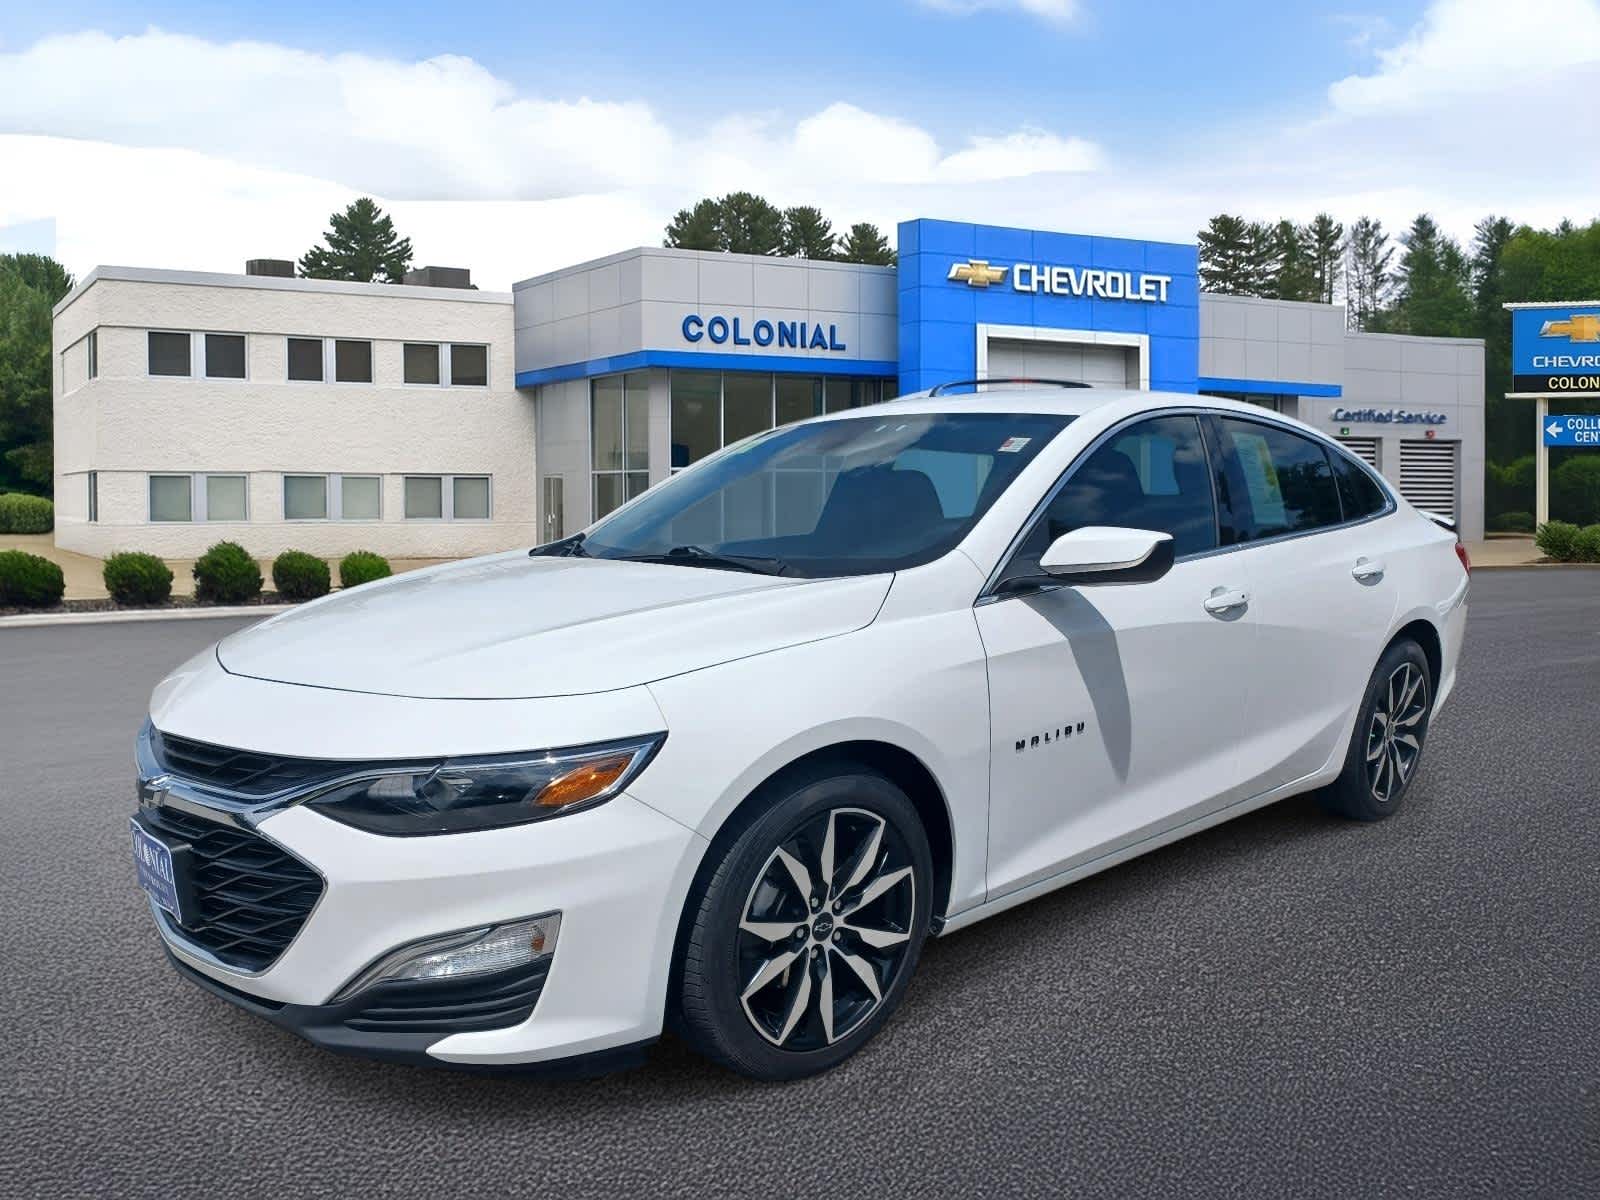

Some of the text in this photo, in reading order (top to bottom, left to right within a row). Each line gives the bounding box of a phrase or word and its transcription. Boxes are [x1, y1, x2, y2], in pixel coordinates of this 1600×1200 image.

[1013, 263, 1171, 303] CHEVROLET
[682, 314, 847, 351] COLONIAL
[1332, 408, 1447, 424] Certified Service
[1574, 431, 1600, 443] CEN
[1015, 721, 1085, 752] MALIBU
